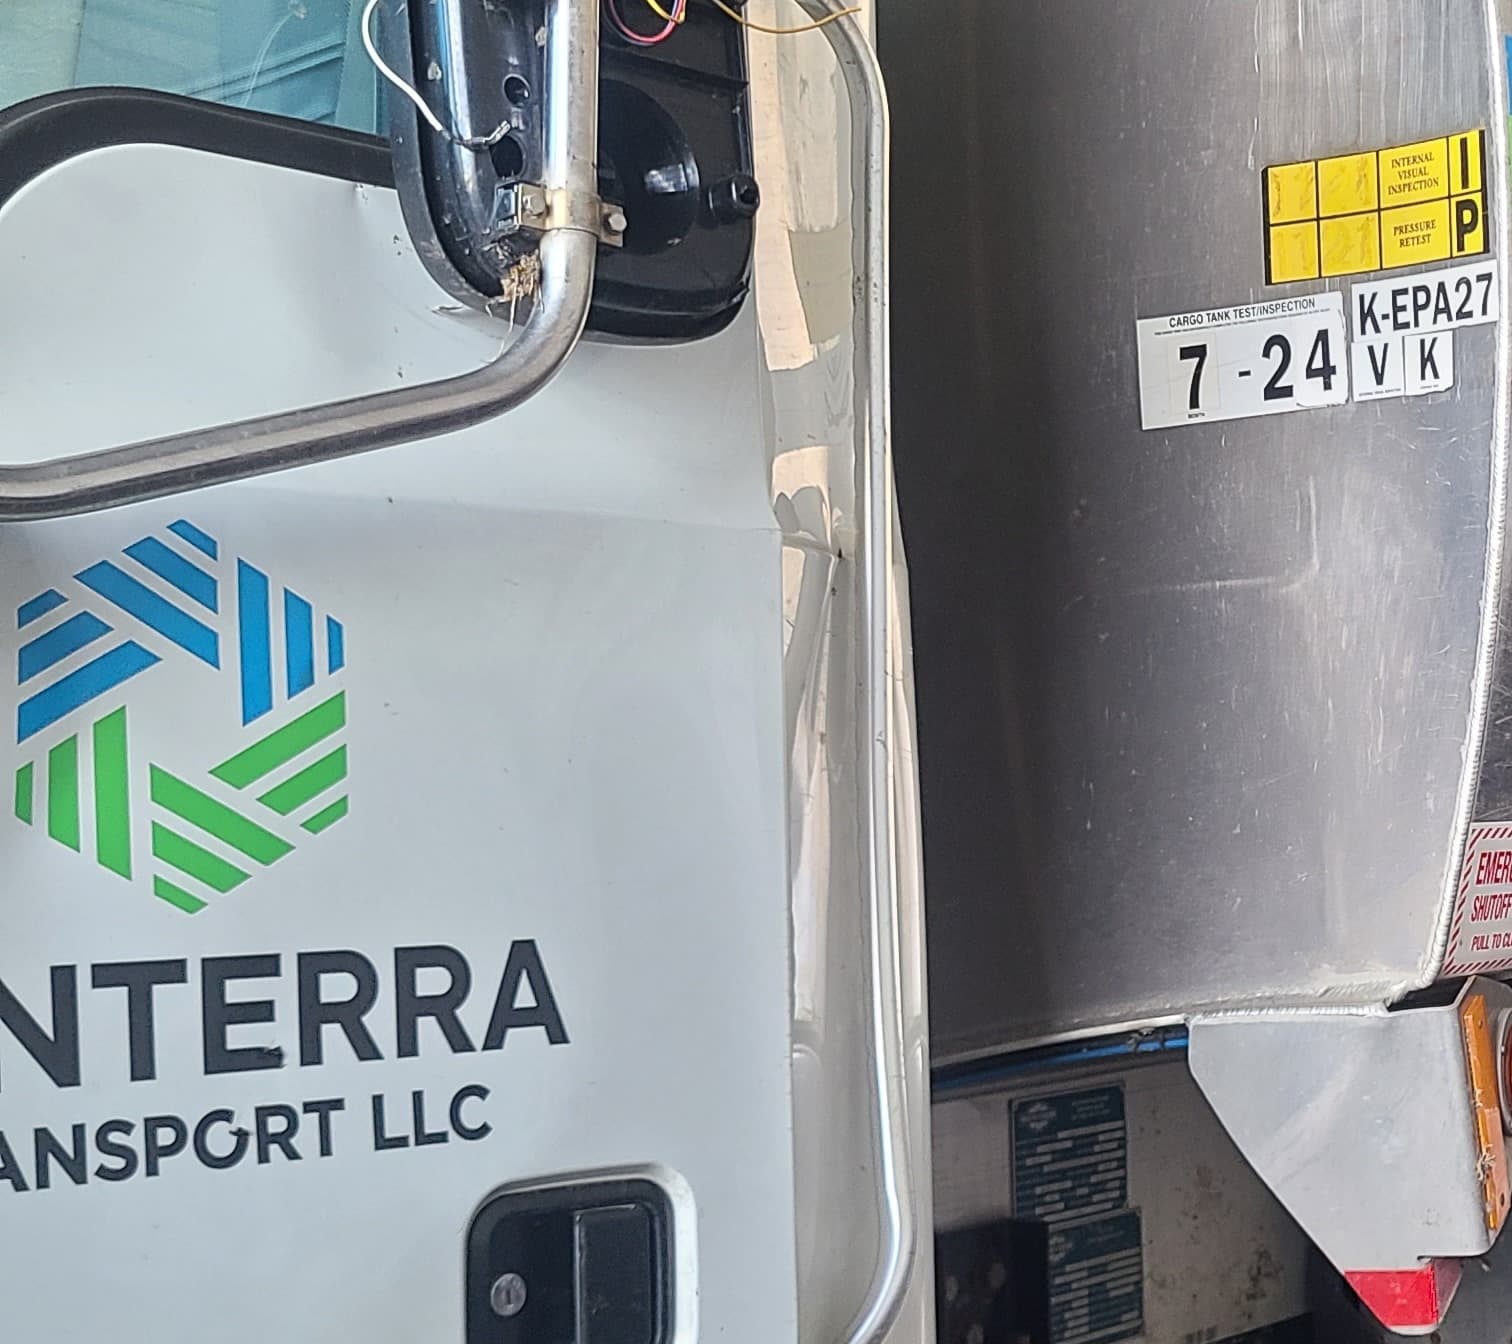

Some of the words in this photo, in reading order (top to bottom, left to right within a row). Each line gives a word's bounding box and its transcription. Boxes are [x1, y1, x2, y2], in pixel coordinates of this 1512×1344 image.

[1391, 151, 1434, 168] INTERNAL
[1387, 177, 1440, 196] INSPECTION
[1398, 167, 1429, 181] VISUAL
[1393, 219, 1437, 235] PRESSURE
[1455, 198, 1479, 252] P
[1399, 234, 1432, 248] RETEST
[1169, 313, 1204, 328] CARGO
[1206, 308, 1232, 323] TANK
[1233, 297, 1316, 319] TEST/INSPECTION
[1358, 272, 1494, 336] K-EPA27
[1179, 343, 1208, 410] 7
[1262, 328, 1337, 402] 24
[1367, 343, 1390, 386] V
[1419, 337, 1441, 381] K
[1471, 933, 1490, 951] PULL
[1491, 933, 1502, 949] TO
[371, 1084, 494, 1151] LLC
